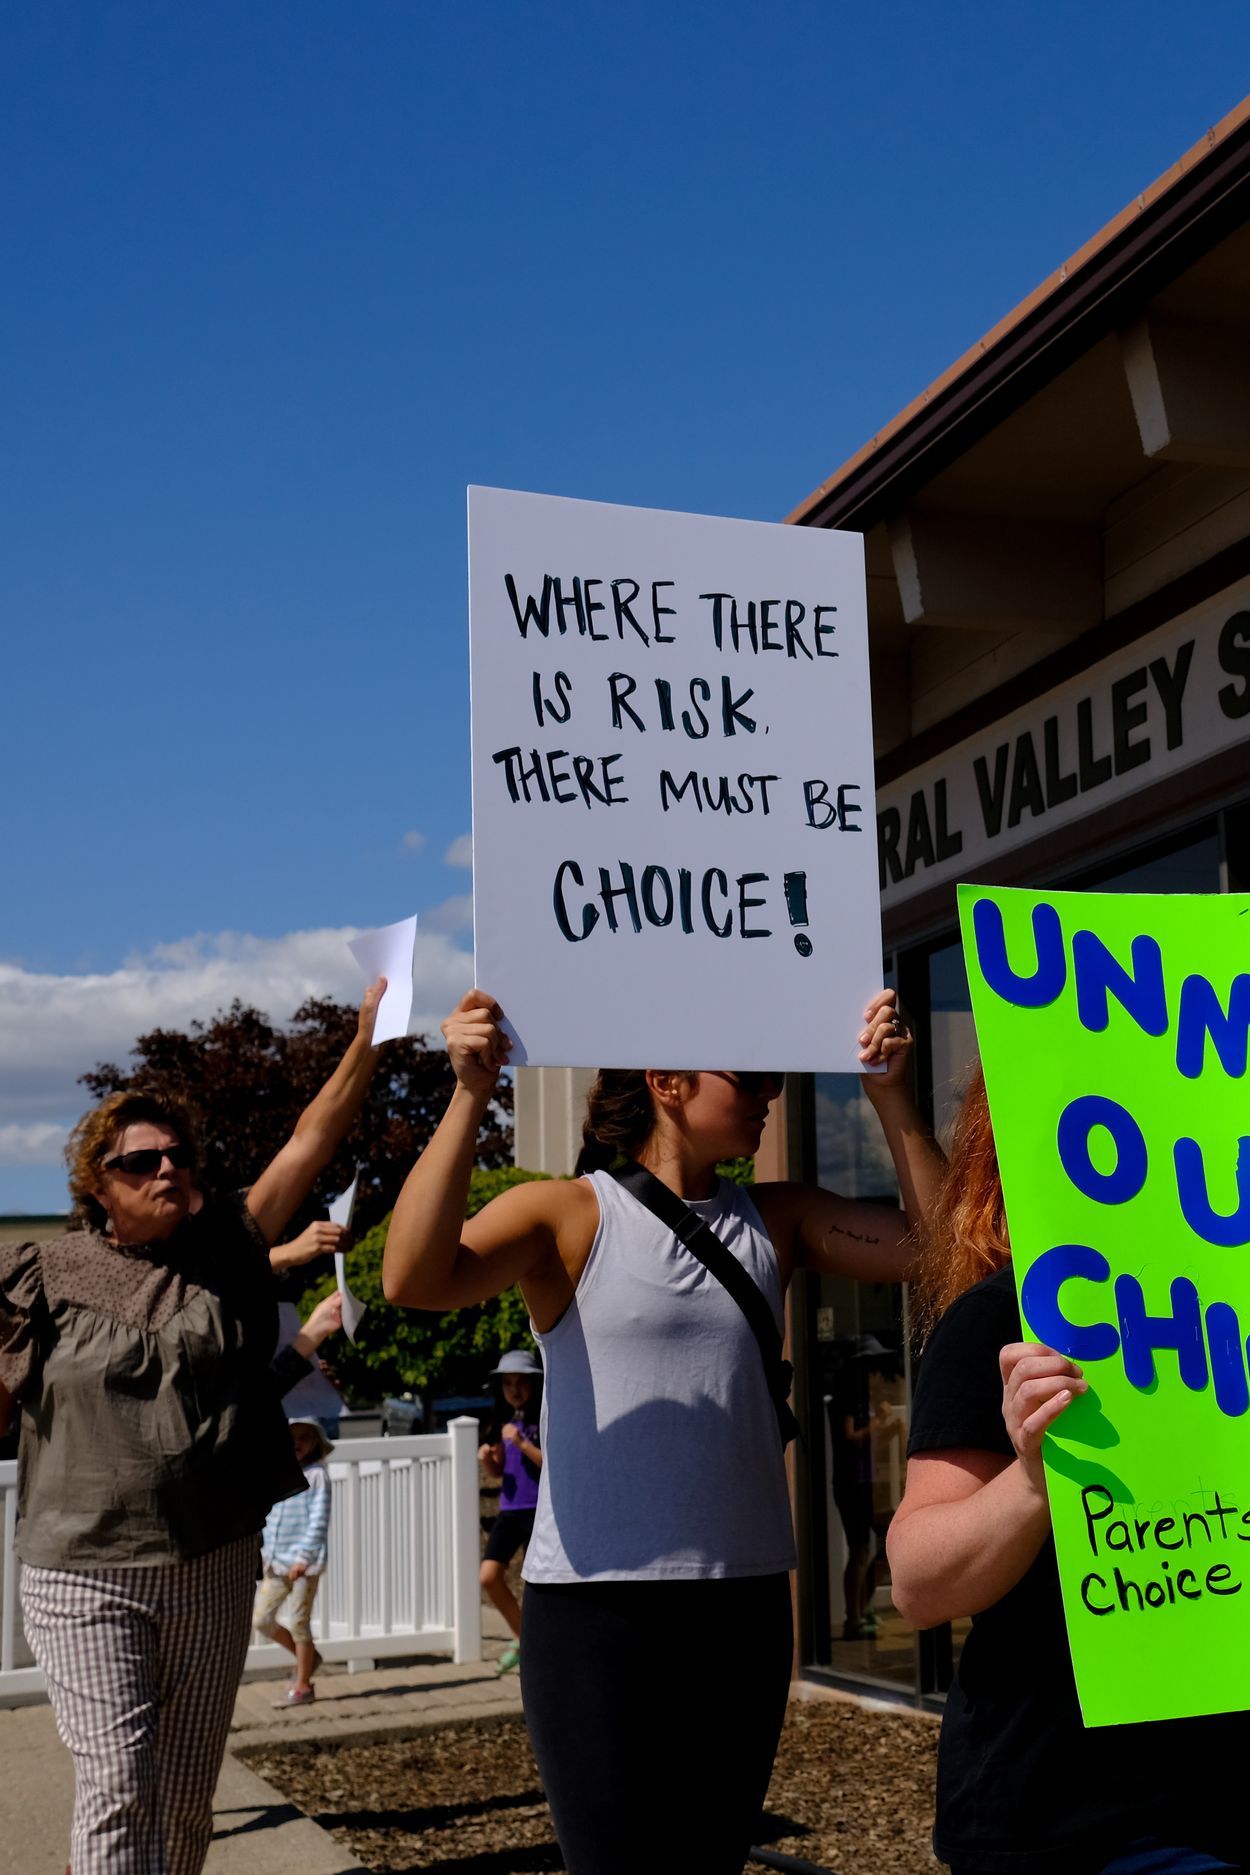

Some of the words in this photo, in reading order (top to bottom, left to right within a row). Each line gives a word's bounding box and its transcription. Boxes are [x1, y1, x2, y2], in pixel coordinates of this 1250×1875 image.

[504, 573, 677, 648] WHERE
[699, 592, 840, 660] THERE
[532, 670, 573, 727] IS
[607, 671, 770, 739] RISK,
[973, 640, 1194, 839] VALLEY
[492, 746, 629, 809] THERE
[660, 769, 782, 816] MUST
[804, 779, 862, 832] BE
[552, 859, 814, 957] CHOICE!
[1080, 1560, 1243, 1616] Choice
